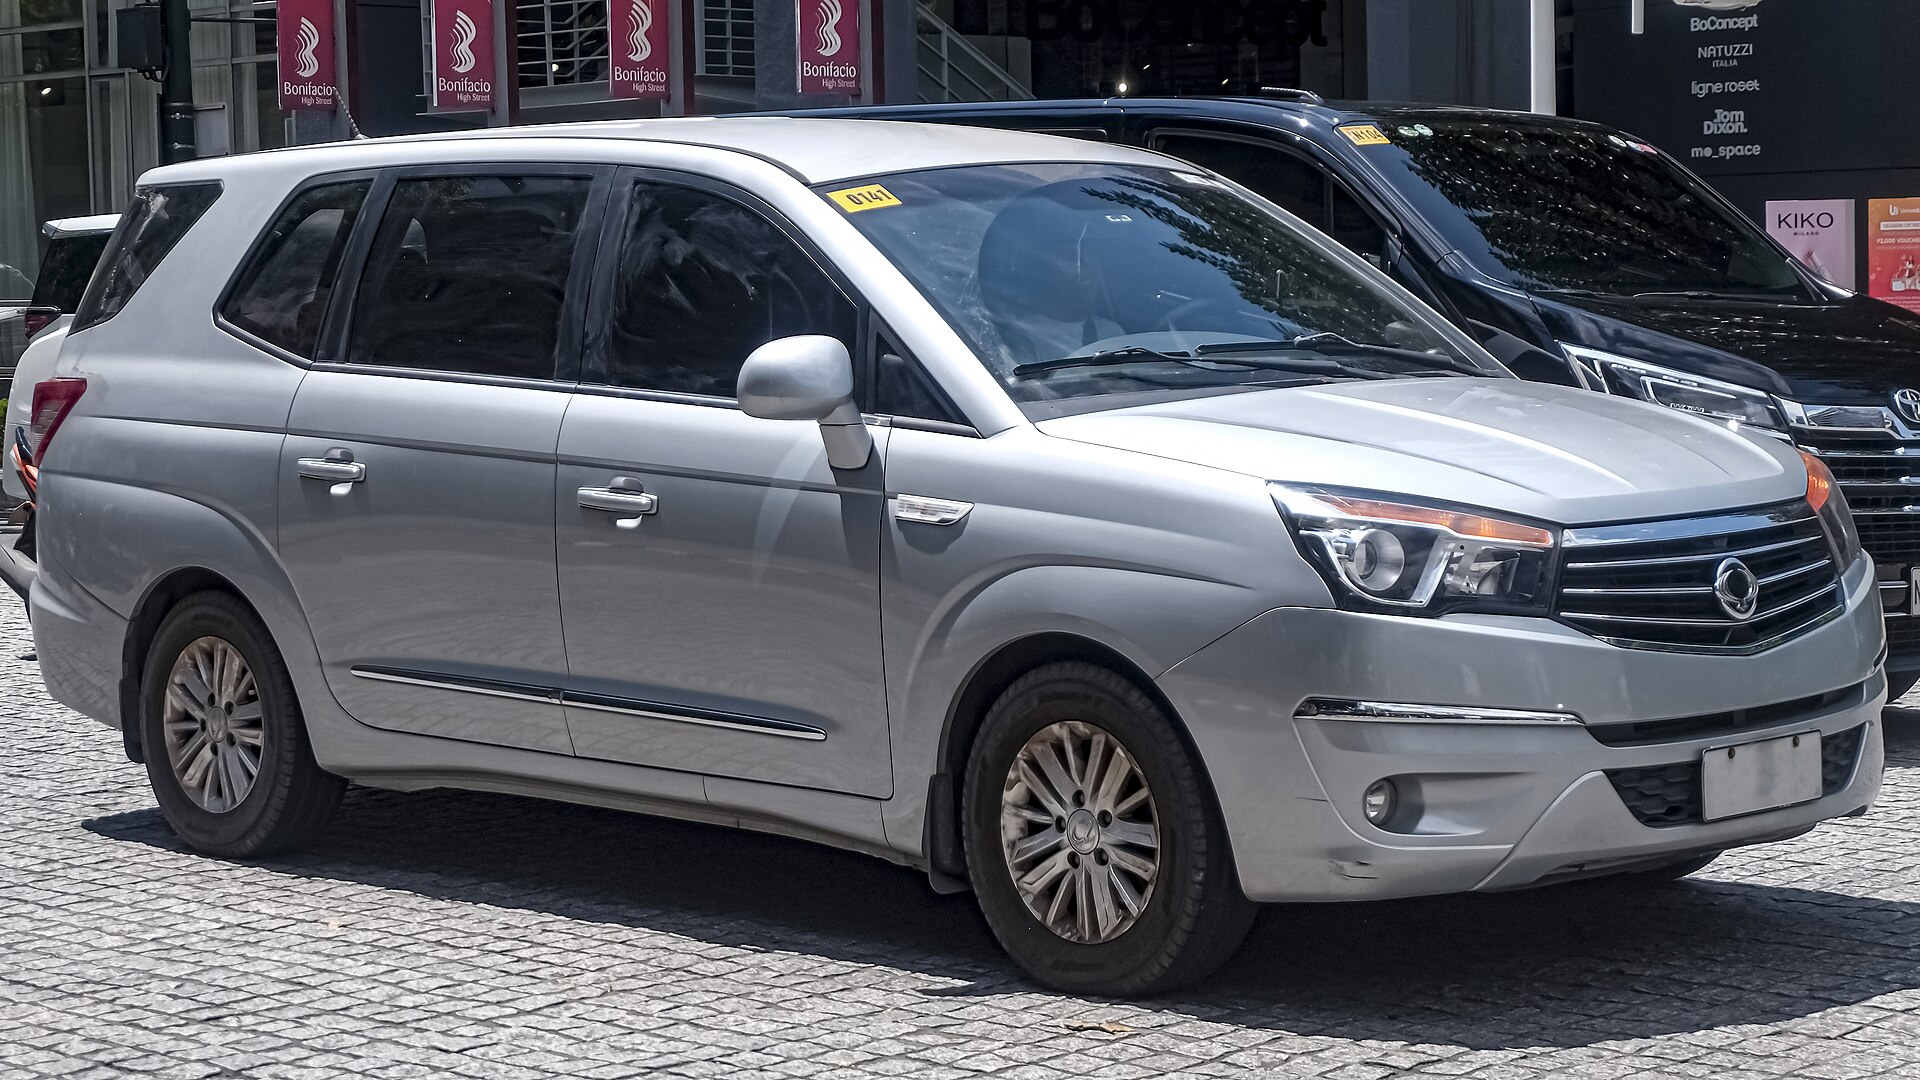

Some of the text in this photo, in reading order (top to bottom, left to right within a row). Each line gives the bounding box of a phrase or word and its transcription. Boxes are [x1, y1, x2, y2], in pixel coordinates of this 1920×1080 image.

[1690, 13, 1759, 32] BoConcept
[1697, 43, 1753, 59] NATUZZI
[803, 61, 857, 78] Bonifacio
[1712, 59, 1738, 68] ITALIA
[614, 66, 667, 82] Bonifacio
[283, 81, 333, 96] Bonifacio
[438, 77, 491, 93] Bonifacio
[632, 82, 666, 94] High Street
[822, 78, 856, 90] High Street
[1691, 79, 1760, 98] ligne roset
[301, 96, 333, 106] High Street
[456, 92, 491, 103] High Street
[1690, 144, 1761, 160] mo_space
[845, 188, 893, 206] 0141
[1777, 212, 1834, 229] KIKO
